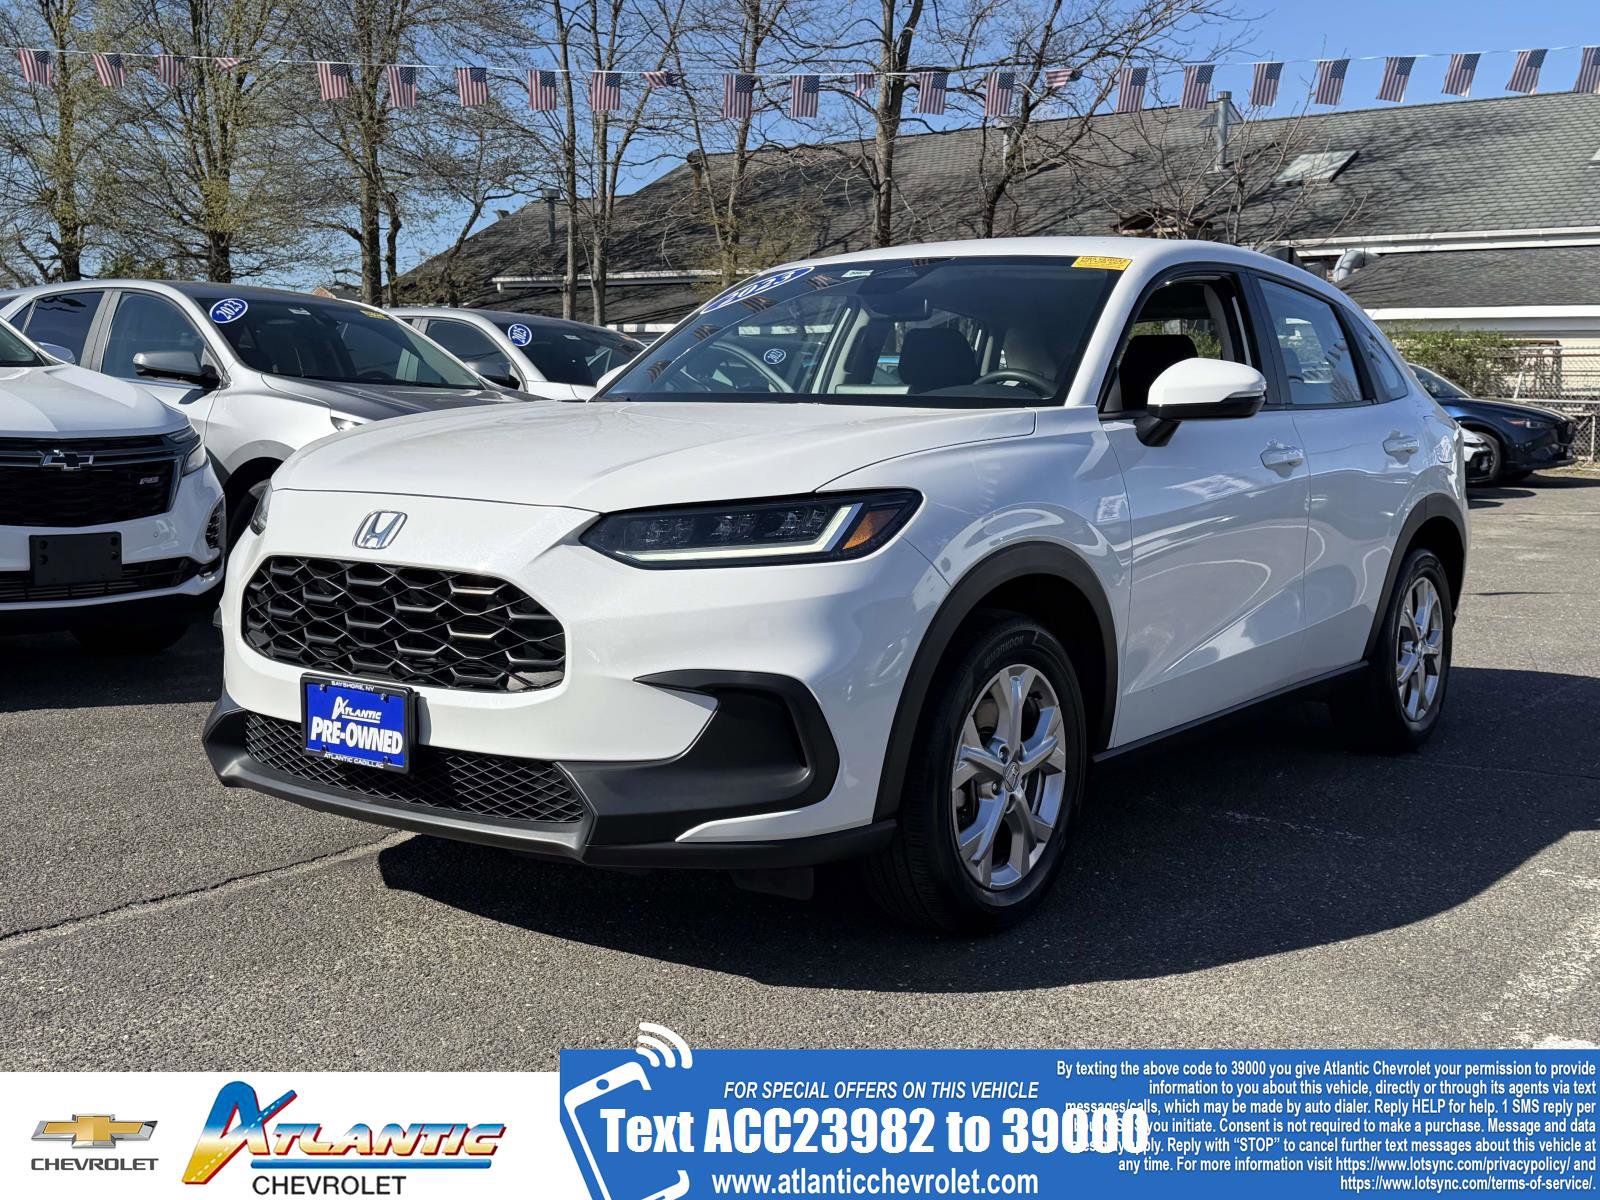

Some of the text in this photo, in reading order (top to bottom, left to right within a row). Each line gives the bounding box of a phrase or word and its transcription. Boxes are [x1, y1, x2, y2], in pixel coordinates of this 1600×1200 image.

[719, 270, 795, 307] 2023
[216, 301, 242, 320] 2023
[331, 696, 382, 719] ATLANTIC
[311, 716, 403, 755] PRE-OWNED
